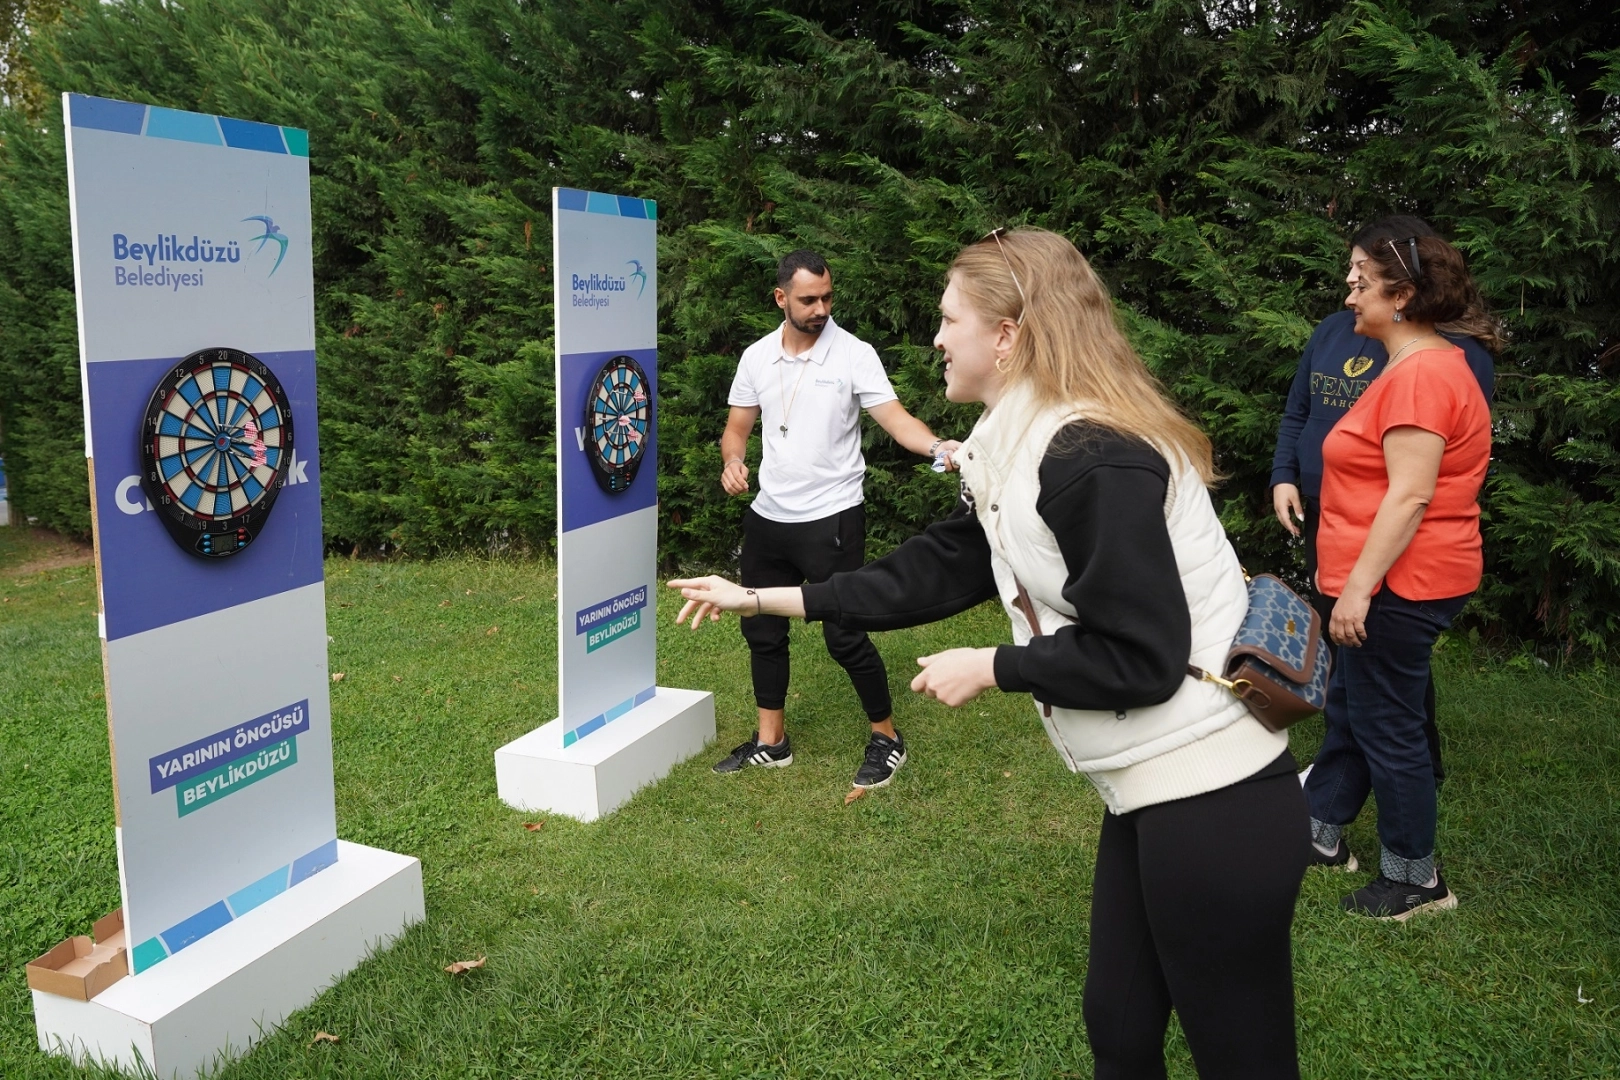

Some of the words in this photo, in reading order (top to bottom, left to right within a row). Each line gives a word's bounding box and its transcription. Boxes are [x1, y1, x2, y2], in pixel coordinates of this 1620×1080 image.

[112, 233, 241, 266] Beylikdüzü
[114, 264, 204, 292] Belediyesi
[572, 273, 626, 294] Beylikdüzü
[572, 293, 610, 311] Belediyesi
[200, 355, 204, 364] 5
[218, 351, 228, 360] 20
[242, 356, 246, 364] 1
[175, 368, 184, 378] 12
[258, 366, 267, 375] 18
[276, 386, 280, 394] 4
[1309, 372, 1371, 398] FENE
[160, 390, 166, 400] 9
[284, 409, 292, 418] 13
[148, 418, 157, 426] 14
[288, 432, 292, 441] 6
[145, 444, 154, 454] 11
[151, 472, 157, 481] 8
[161, 495, 171, 505] 16
[260, 502, 266, 510] 2
[241, 514, 250, 524] 17
[198, 520, 206, 530] 19
[222, 521, 228, 530] 3
[579, 604, 612, 627] YARININ
[612, 588, 645, 613] ÖNCÜSÜ
[589, 612, 638, 647] BEYLİKDÜZÜ
[156, 737, 231, 780] YARININ
[233, 706, 304, 749] ÖNCÜSÜ
[183, 740, 290, 806] BEYLİKDÜZÜ
